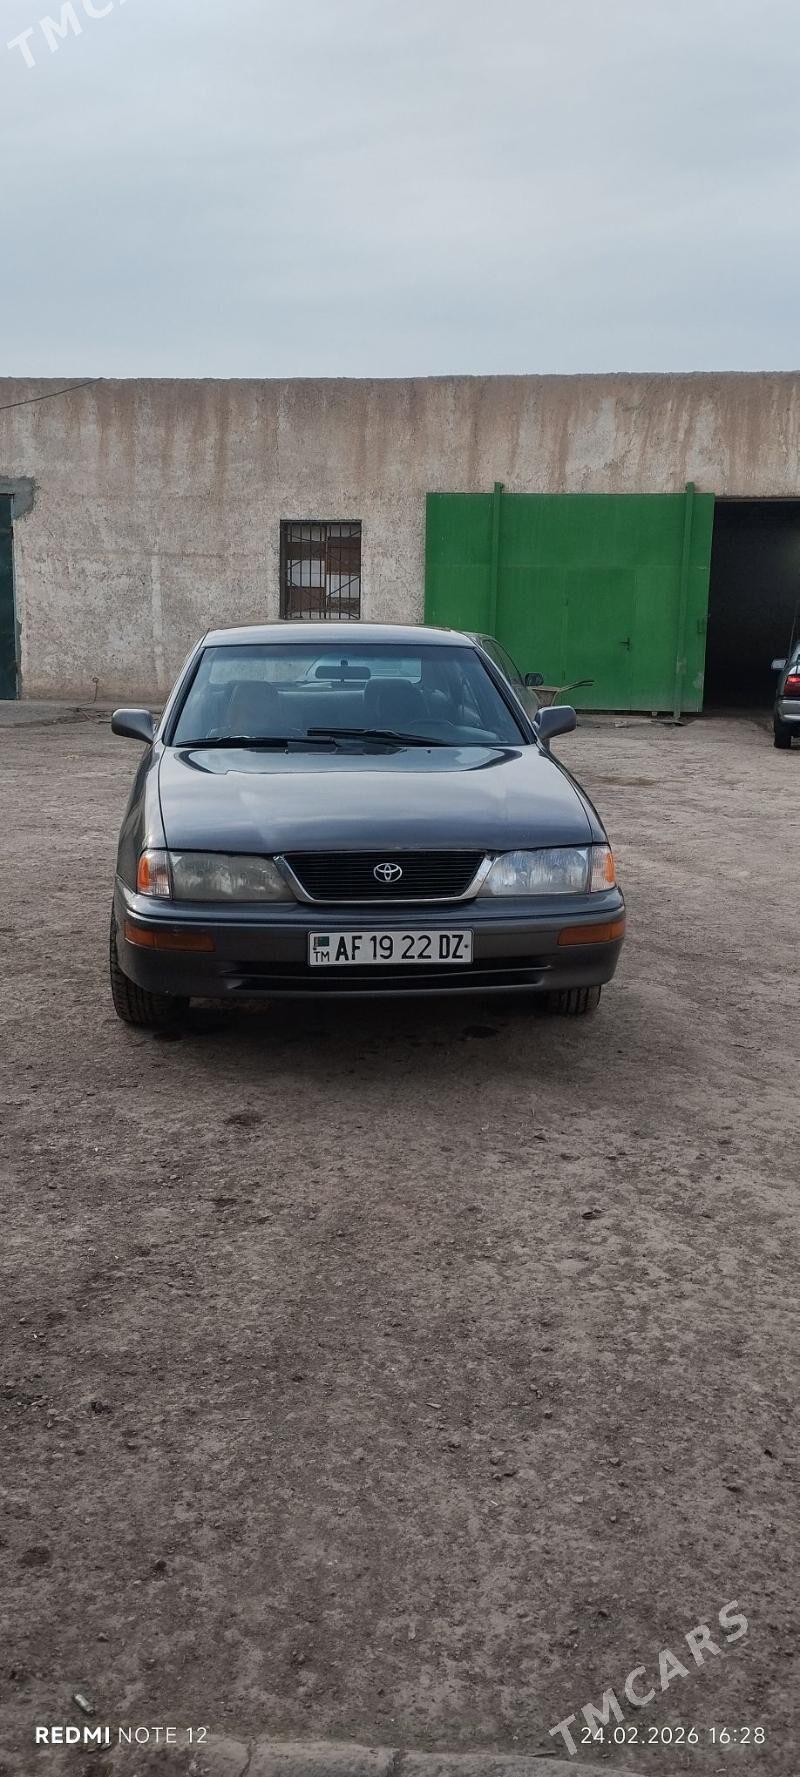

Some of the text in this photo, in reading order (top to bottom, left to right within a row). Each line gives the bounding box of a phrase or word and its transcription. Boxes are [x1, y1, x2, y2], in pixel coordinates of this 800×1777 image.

[313, 950, 330, 963] TM
[335, 934, 464, 962] AF 19 22 DZ
